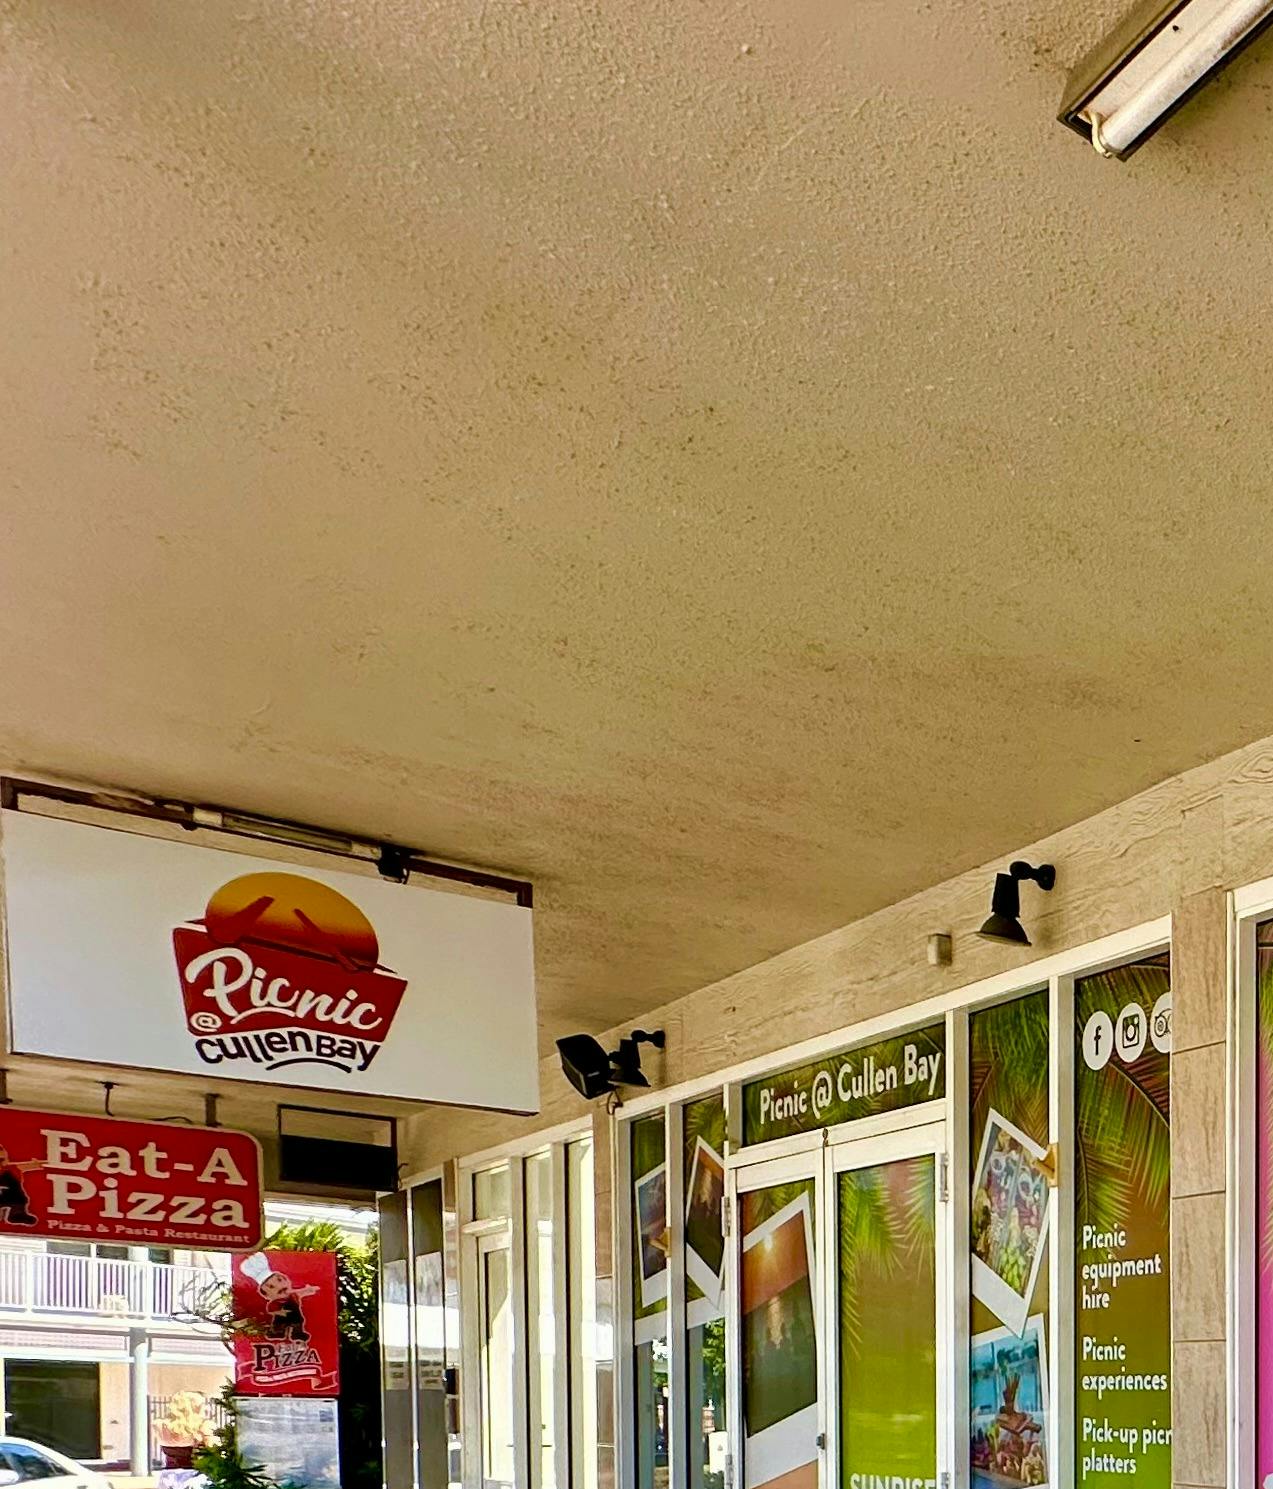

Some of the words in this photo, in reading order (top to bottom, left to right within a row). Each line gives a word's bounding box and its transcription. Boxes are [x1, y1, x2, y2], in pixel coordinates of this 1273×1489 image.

[185, 947, 382, 1030] Picnic
[189, 1012, 222, 1032] @
[760, 1080, 807, 1125] Picnic
[812, 1070, 832, 1119] @
[837, 1063, 898, 1102] Cullen
[904, 1043, 942, 1096] Bay
[40, 1129, 247, 1186] Eat-A
[46, 1174, 249, 1229] Pizza
[47, 1219, 92, 1232] Pizza
[97, 1224, 110, 1233] &
[115, 1224, 159, 1237] Pasta
[164, 1228, 250, 1244] Restaurant
[1082, 1223, 1127, 1250] Picnic
[1082, 1254, 1161, 1290] equipment
[1082, 1285, 1110, 1309] hire
[1082, 1336, 1127, 1361] Picnic
[1082, 1366, 1168, 1400] experiences
[1082, 1417, 1138, 1454] Pick-up
[1082, 1447, 1137, 1481] platters
